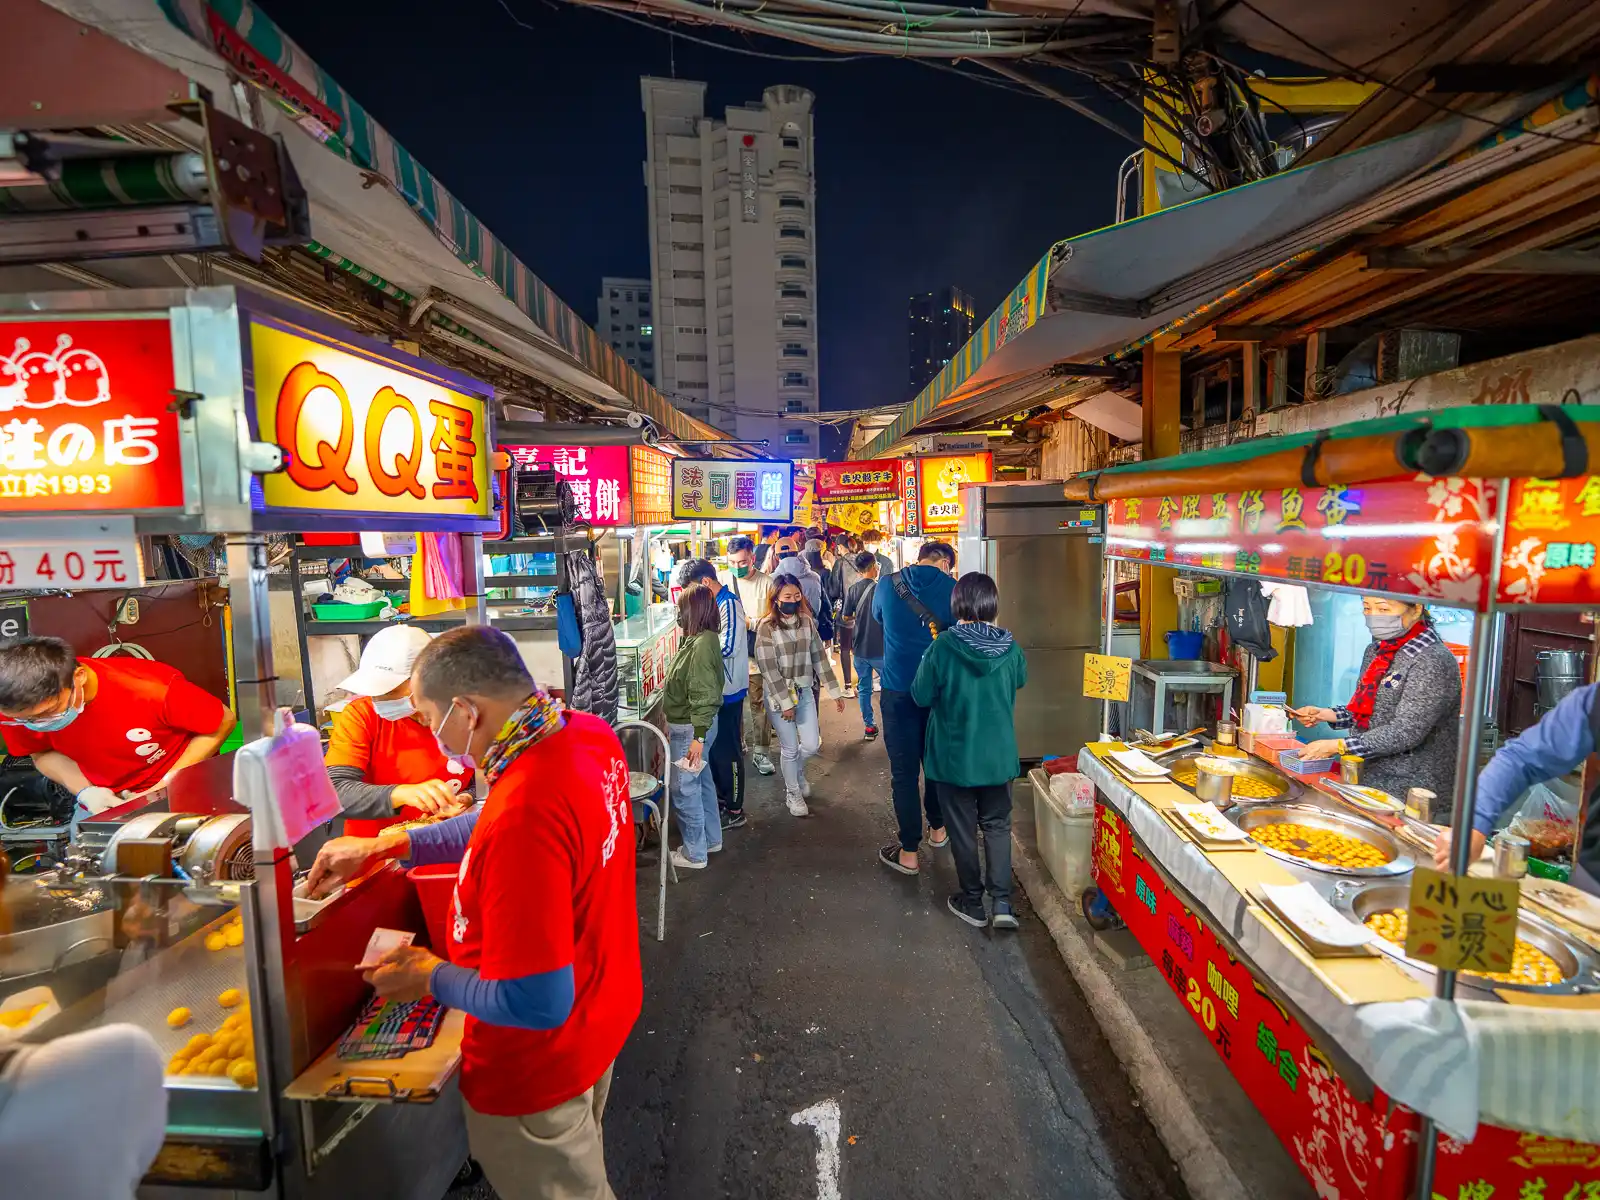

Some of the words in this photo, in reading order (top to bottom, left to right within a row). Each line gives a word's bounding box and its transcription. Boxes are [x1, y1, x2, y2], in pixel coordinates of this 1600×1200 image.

[275, 360, 479, 504] QQ蛋
[681, 466, 704, 513] 法式
[1543, 540, 1596, 569] 原味
[1136, 873, 1157, 915] 原味
[1425, 879, 1507, 912] 小心
[1256, 1020, 1300, 1092] 綜合
